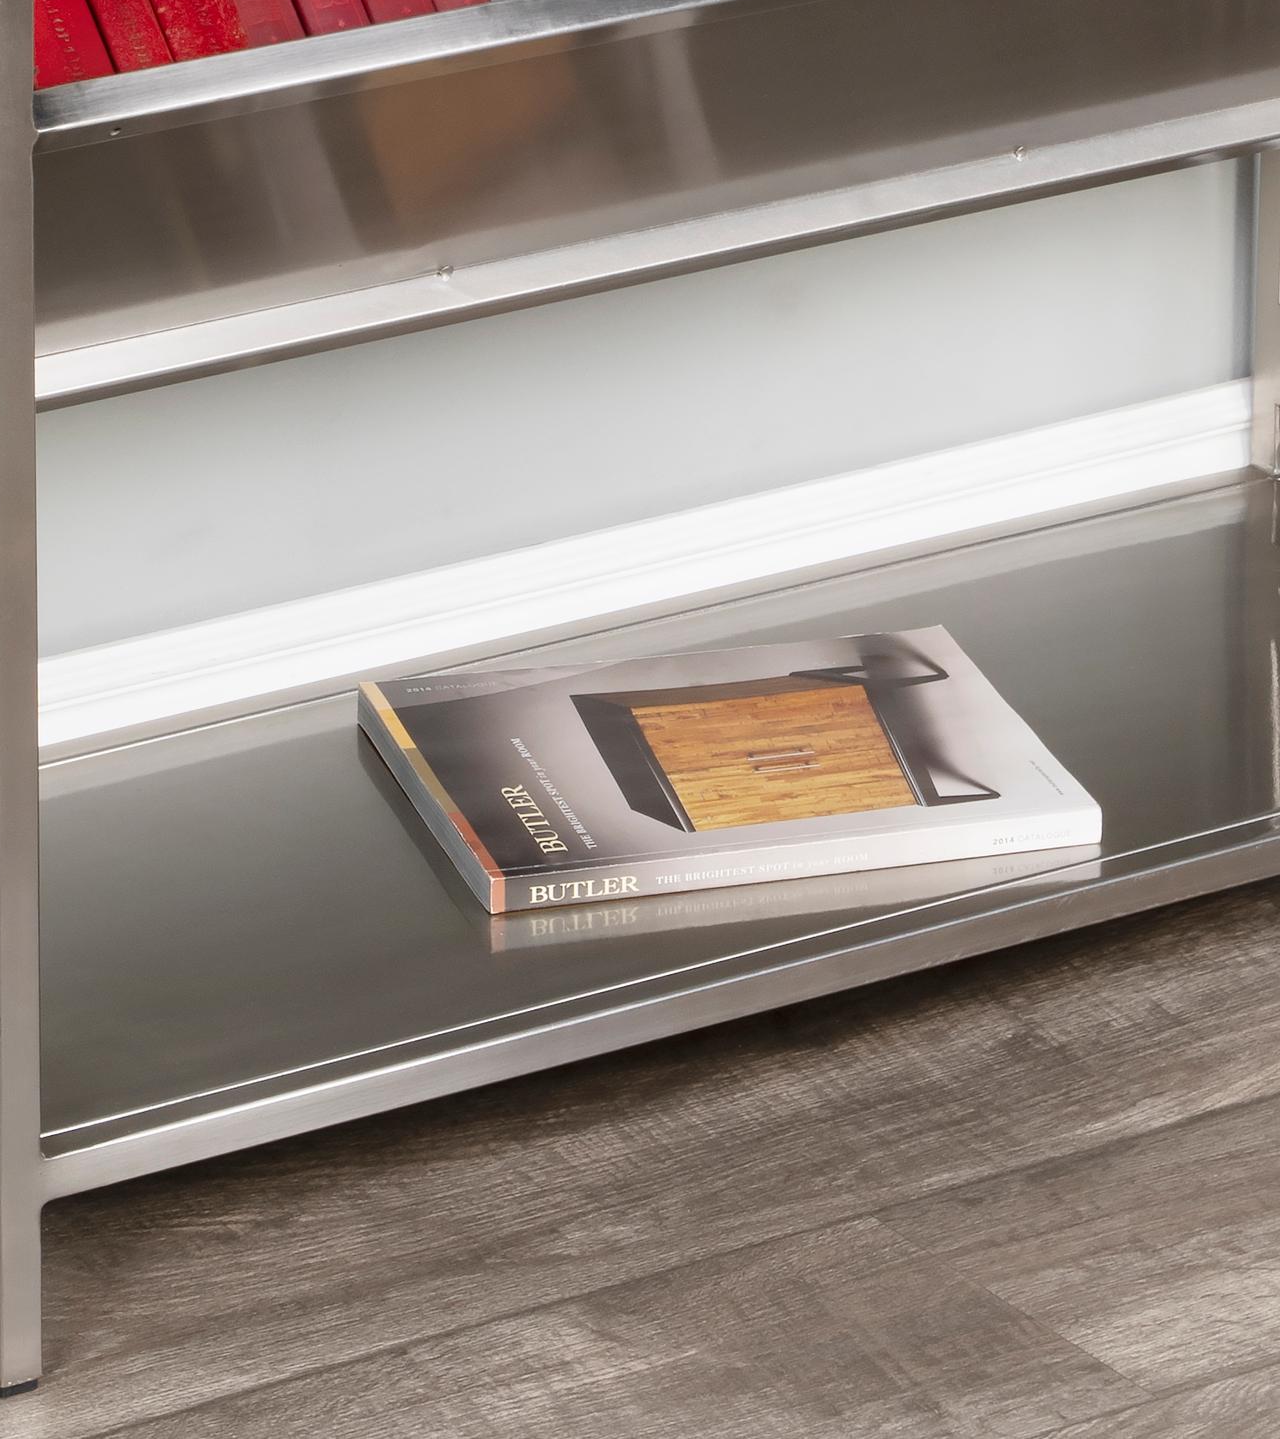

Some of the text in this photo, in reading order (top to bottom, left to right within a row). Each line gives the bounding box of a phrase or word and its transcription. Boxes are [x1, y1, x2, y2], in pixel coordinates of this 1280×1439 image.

[510, 737, 533, 759] ROOM
[500, 783, 569, 855] BUTLER
[552, 794, 587, 835] BRIGHTEST
[580, 833, 598, 850] THE
[992, 837, 1015, 846] 2014
[528, 875, 640, 904] BUTLER
[655, 875, 682, 886] THE
[685, 864, 755, 882] BRIGHTEST
[758, 861, 791, 873] SPOT
[833, 852, 869, 865] ROOM
